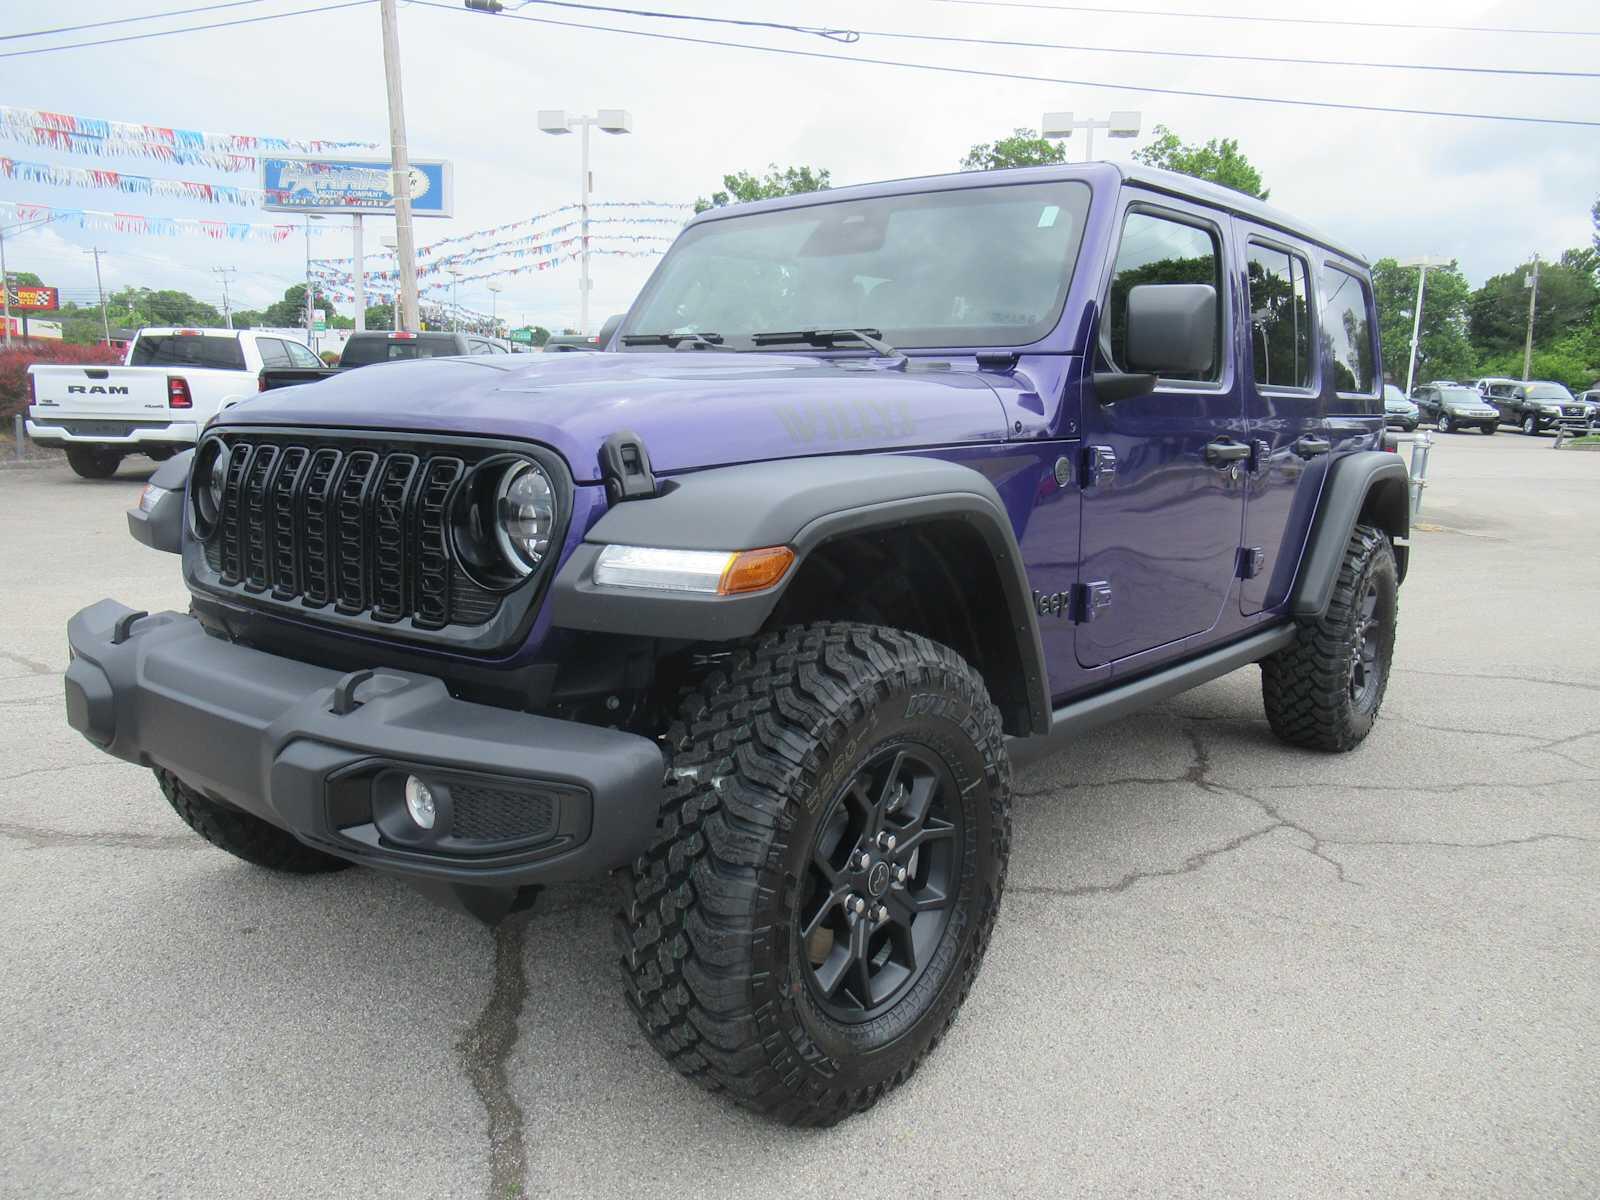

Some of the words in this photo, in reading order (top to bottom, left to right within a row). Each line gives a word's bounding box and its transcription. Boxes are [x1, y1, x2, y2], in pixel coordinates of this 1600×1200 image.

[318, 189, 344, 198] MOTOR
[346, 190, 384, 199] COMPANY
[68, 385, 129, 395] RAM
